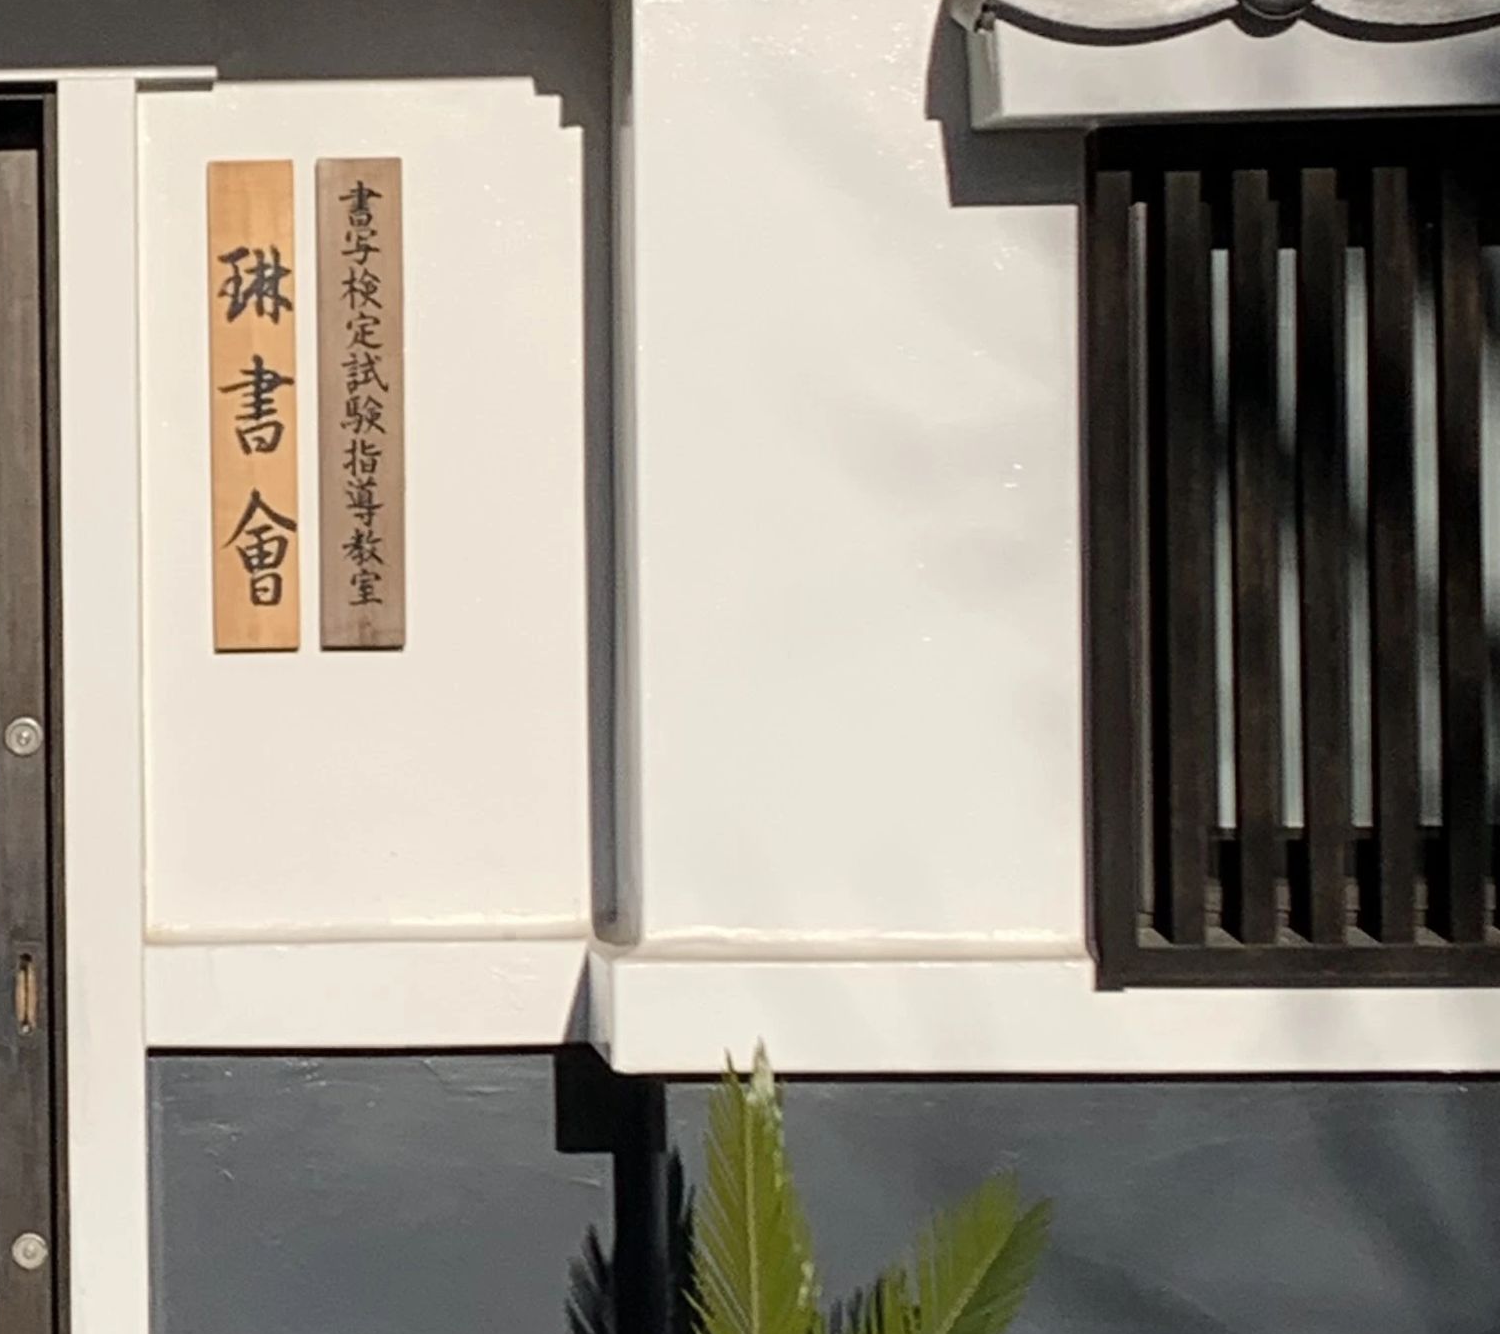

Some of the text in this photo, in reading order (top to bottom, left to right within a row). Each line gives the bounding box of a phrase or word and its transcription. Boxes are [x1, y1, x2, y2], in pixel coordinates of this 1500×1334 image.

[338, 179, 389, 607] 書写検定試験指導教室
